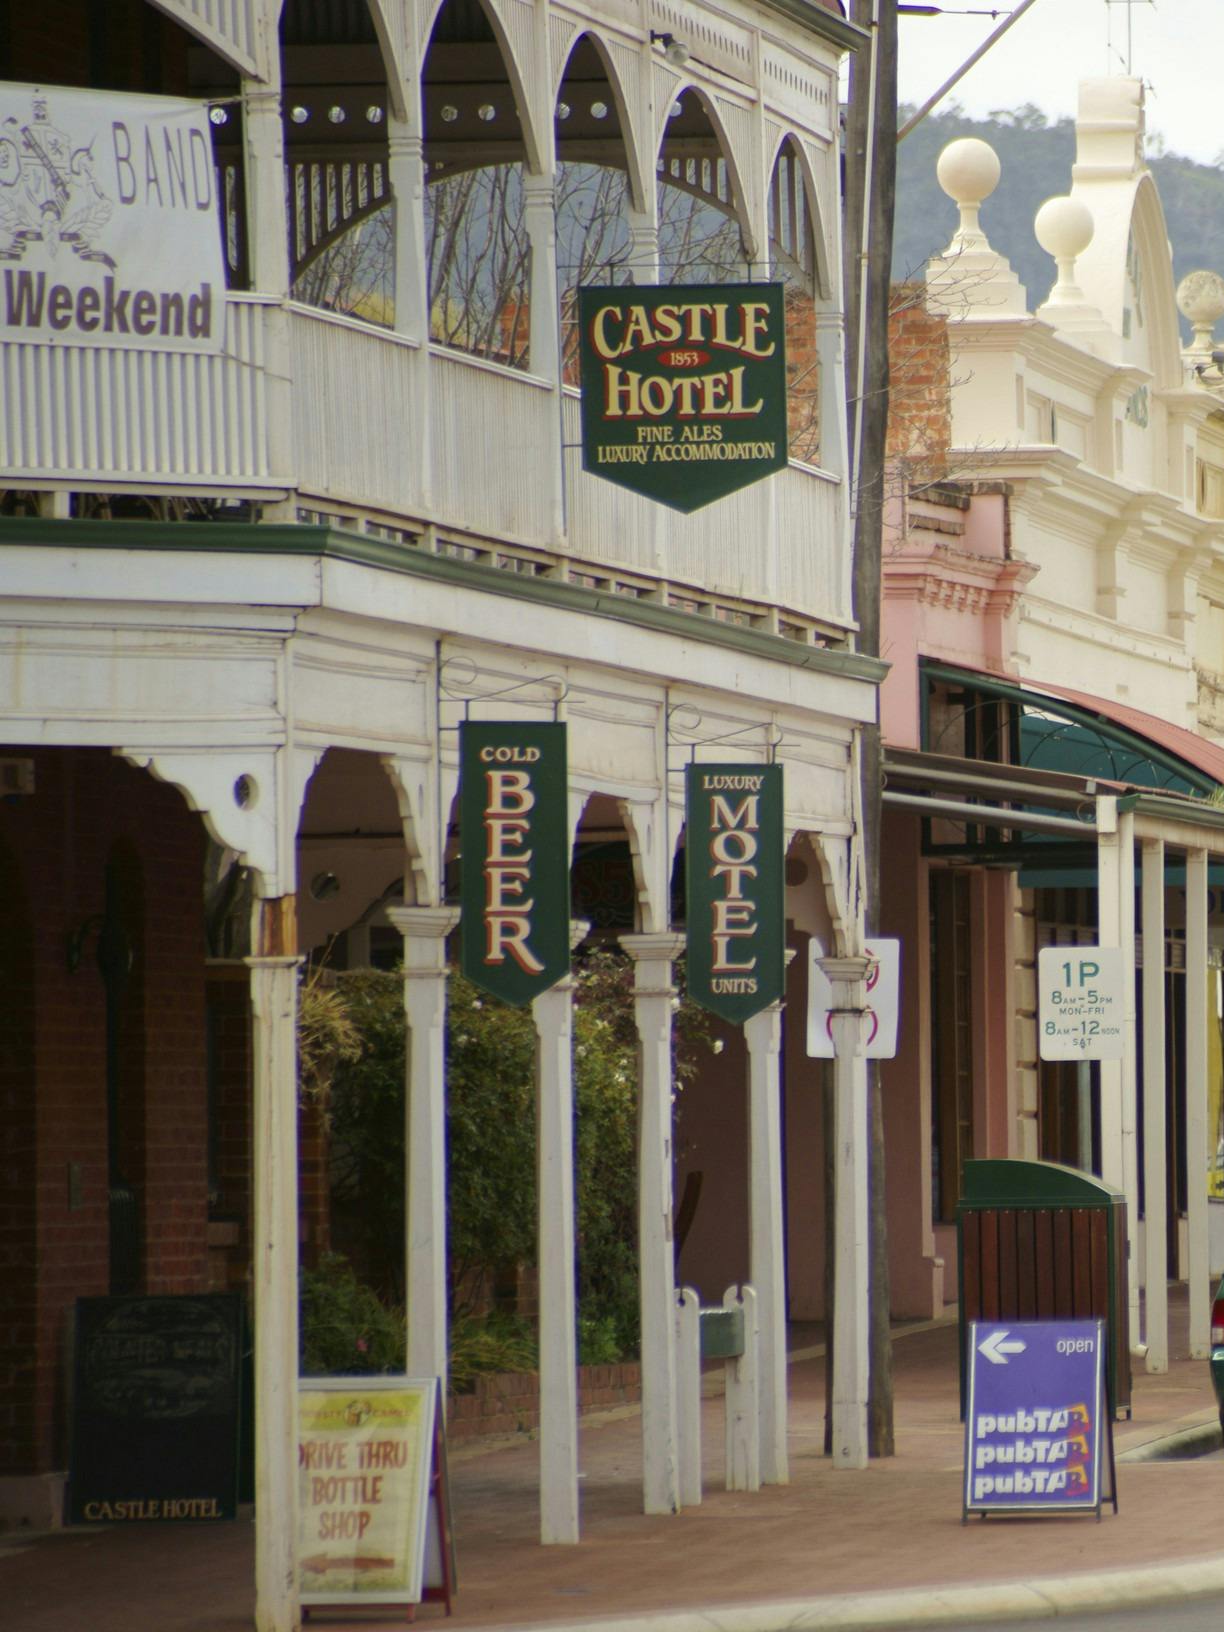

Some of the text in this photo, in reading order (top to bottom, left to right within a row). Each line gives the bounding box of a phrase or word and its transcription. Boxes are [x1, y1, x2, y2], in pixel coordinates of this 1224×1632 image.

[112, 121, 211, 211] BAND
[4, 269, 211, 338] Weekend
[591, 303, 776, 360] CASTLE
[670, 351, 699, 366] 1853
[604, 363, 764, 418] HOTEL
[637, 425, 723, 443] FINE ALES
[598, 443, 776, 465] LUXURY ACCOMMODATION
[480, 747, 541, 763] COLD
[703, 775, 764, 791] LUXURY
[484, 770, 545, 976] BEER
[710, 795, 760, 974] MOTEL
[711, 978, 758, 993] UNITS
[1062, 961, 1100, 987] 1P
[1059, 1007, 1105, 1016] MON-FRI
[1073, 1038, 1092, 1046] SAT
[1056, 1338, 1094, 1356] open
[357, 1440, 408, 1469] THRU
[312, 1475, 383, 1505] BOTTLE
[84, 1498, 223, 1520] CASTLE HOTEL
[318, 1511, 371, 1540] SHOP
